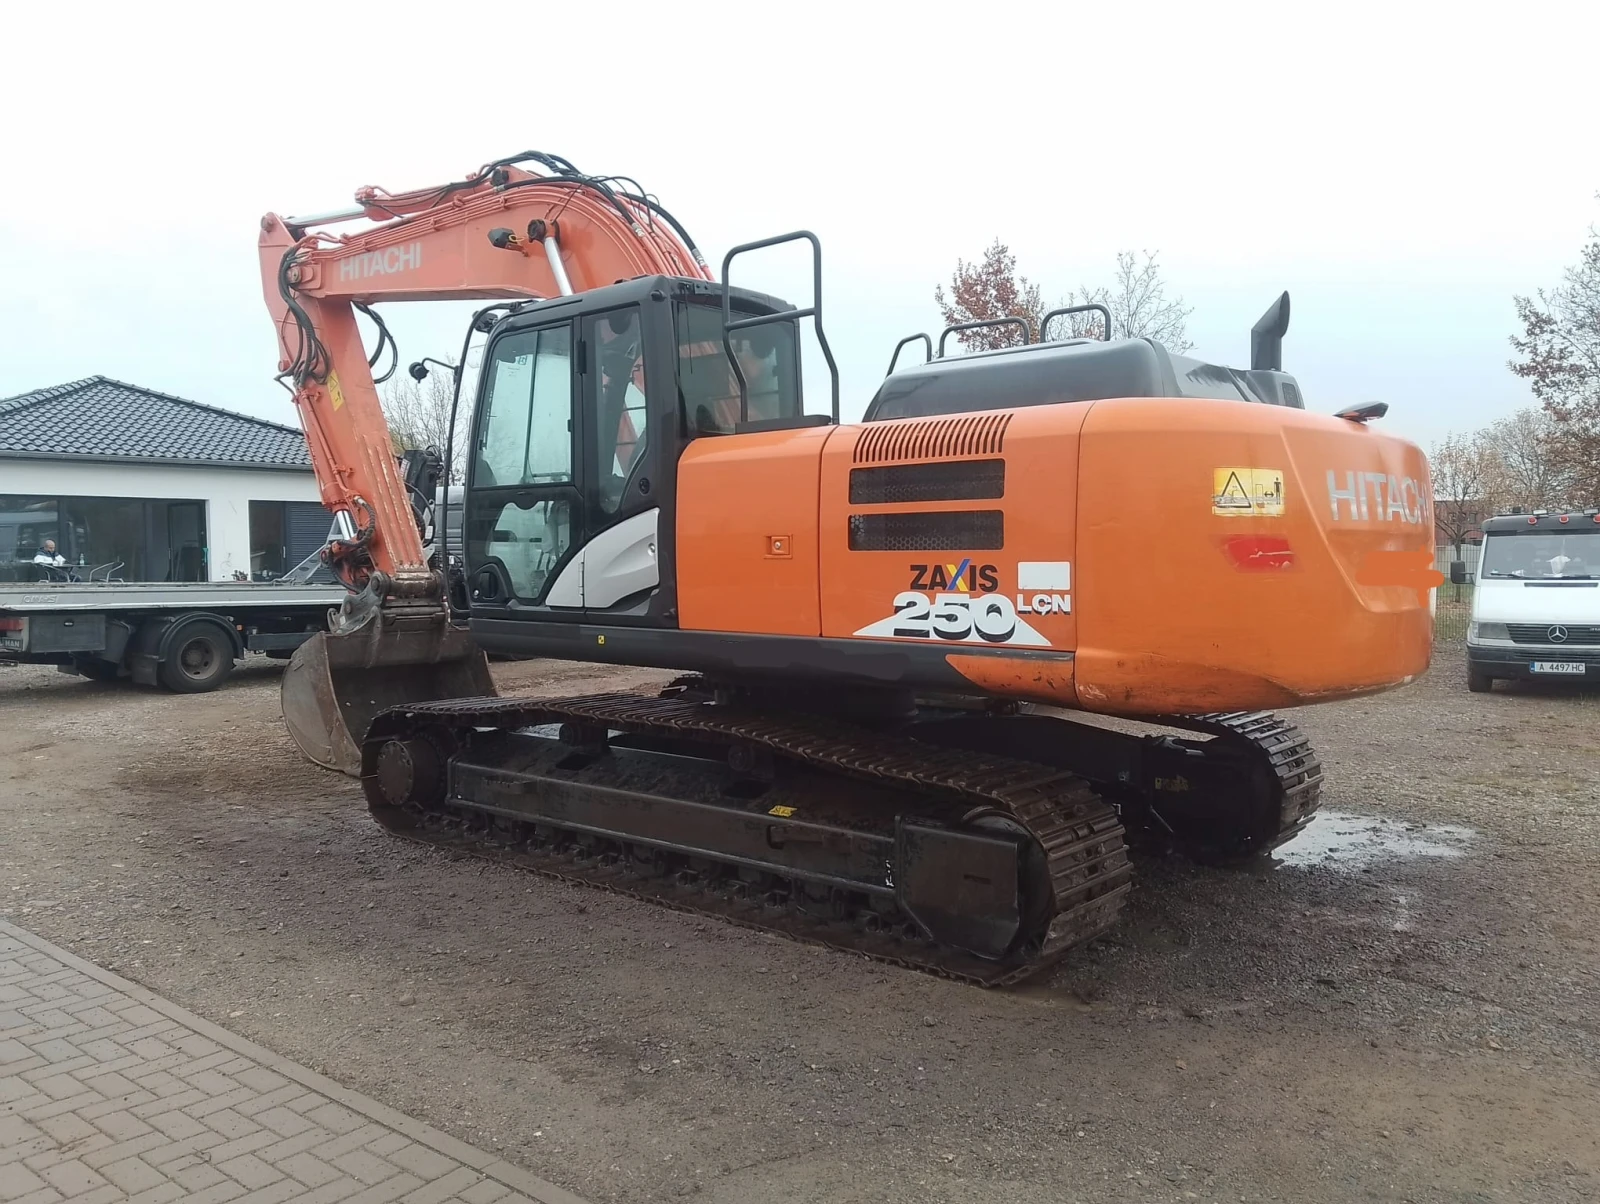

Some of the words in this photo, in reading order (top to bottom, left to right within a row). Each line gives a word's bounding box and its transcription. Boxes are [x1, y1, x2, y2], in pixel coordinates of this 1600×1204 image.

[340, 242, 422, 281] HITACHI
[910, 558, 999, 592] ZAXIS
[893, 591, 1016, 643] 250
[1539, 663, 1545, 672] A
[1549, 663, 1570, 672] 4497
